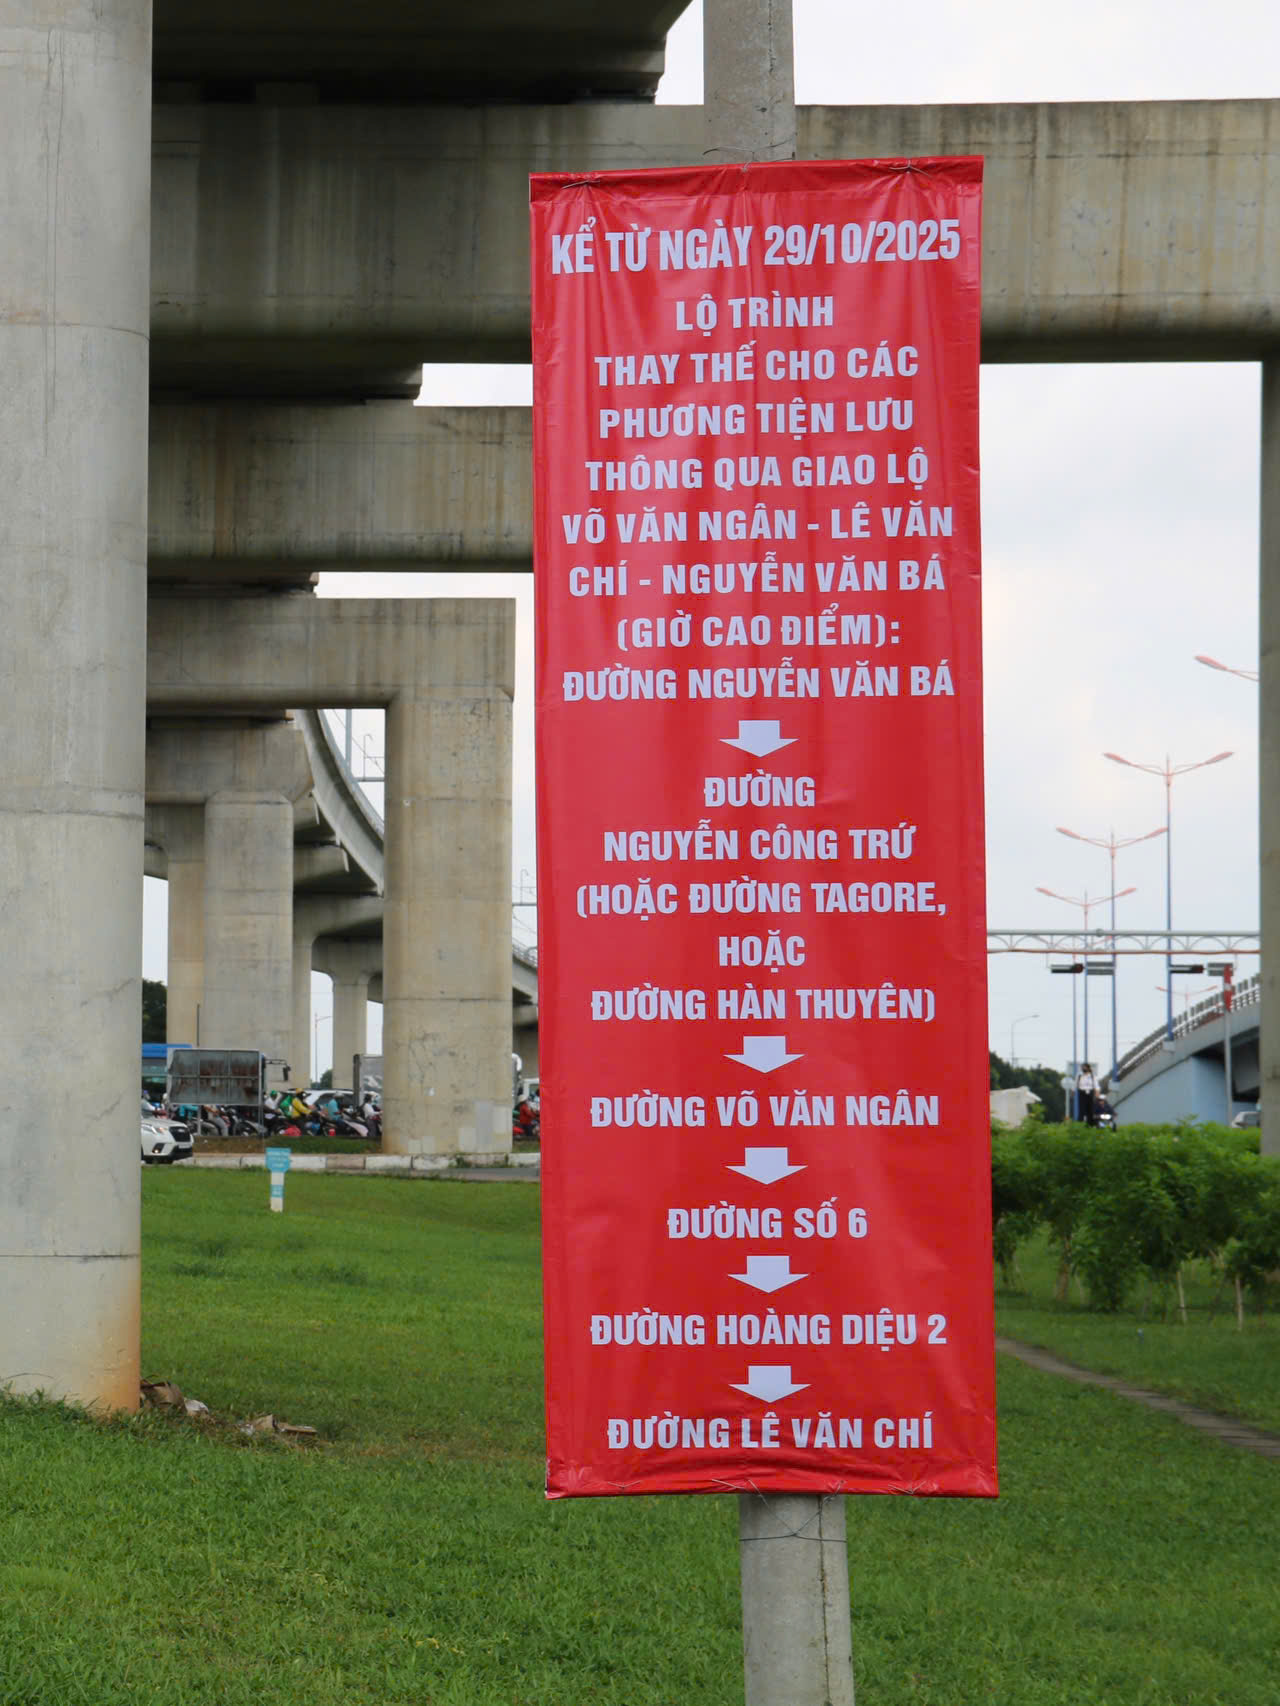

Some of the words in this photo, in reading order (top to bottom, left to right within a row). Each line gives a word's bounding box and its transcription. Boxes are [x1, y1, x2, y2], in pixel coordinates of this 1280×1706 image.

[552, 215, 595, 274] KỂ
[605, 223, 651, 272] TỪ
[659, 219, 753, 271] NGÀY
[764, 219, 960, 266] 29/10/2025
[676, 293, 717, 337] LỘ
[727, 290, 833, 328] TRÌNH
[594, 354, 680, 386] THAY
[690, 341, 754, 383] THẾ
[766, 349, 835, 381] CHO
[847, 340, 918, 379] CÁC
[600, 402, 745, 439] PHƯƠNG
[756, 397, 834, 440] TIỆN
[846, 397, 913, 432] LƯU
[585, 454, 703, 491] THÔNG
[714, 456, 782, 491] QUA
[792, 454, 875, 487] GIAO
[888, 446, 929, 490] LỘ
[562, 507, 605, 545] VÕ
[615, 506, 687, 543] VĂN
[699, 503, 796, 541] NGÂN
[831, 501, 870, 539] LÊ
[882, 500, 952, 537] VĂN
[569, 560, 628, 597] CHÍ
[663, 552, 805, 595] NGUYỄN
[815, 555, 887, 592] VĂN
[899, 553, 945, 590] BÁ
[617, 610, 692, 652] (GIỜ
[702, 615, 771, 647] CAO
[780, 603, 899, 648] ĐIỂM):
[562, 662, 676, 701] ĐƯỜNG
[688, 658, 819, 699] NGUYỄN
[830, 660, 898, 698] VĂN
[910, 659, 954, 696] BÁ
[703, 769, 815, 807] ĐƯỜNG
[604, 819, 738, 862] NGUYỄN
[750, 823, 837, 860] CÔNG
[848, 820, 917, 859] TRỨ
[577, 877, 678, 921] (HOẶC
[688, 875, 801, 913] ĐƯỜNG
[811, 881, 946, 916] TAGORE,
[719, 929, 805, 973] HOẶC
[590, 982, 706, 1021] ĐƯỜNG
[718, 983, 786, 1019] HÀN
[796, 982, 935, 1022] THUYÊN)
[590, 1089, 705, 1127] ĐƯỜNG
[716, 1090, 758, 1127] VÕ
[769, 1089, 835, 1126] VĂN
[846, 1089, 939, 1126] NGÂN
[667, 1201, 782, 1239] ĐƯỜNG
[794, 1199, 837, 1239] SỐ
[848, 1208, 867, 1238] 6
[590, 1307, 705, 1346] ĐƯỜNG
[717, 1308, 830, 1345] HOÀNG
[842, 1308, 917, 1352] DIỆU
[927, 1314, 947, 1344] 2
[607, 1411, 729, 1449] ĐƯỜNG
[741, 1412, 780, 1448] LÊ
[792, 1412, 862, 1448] VĂN
[874, 1412, 932, 1449] CHÍ
